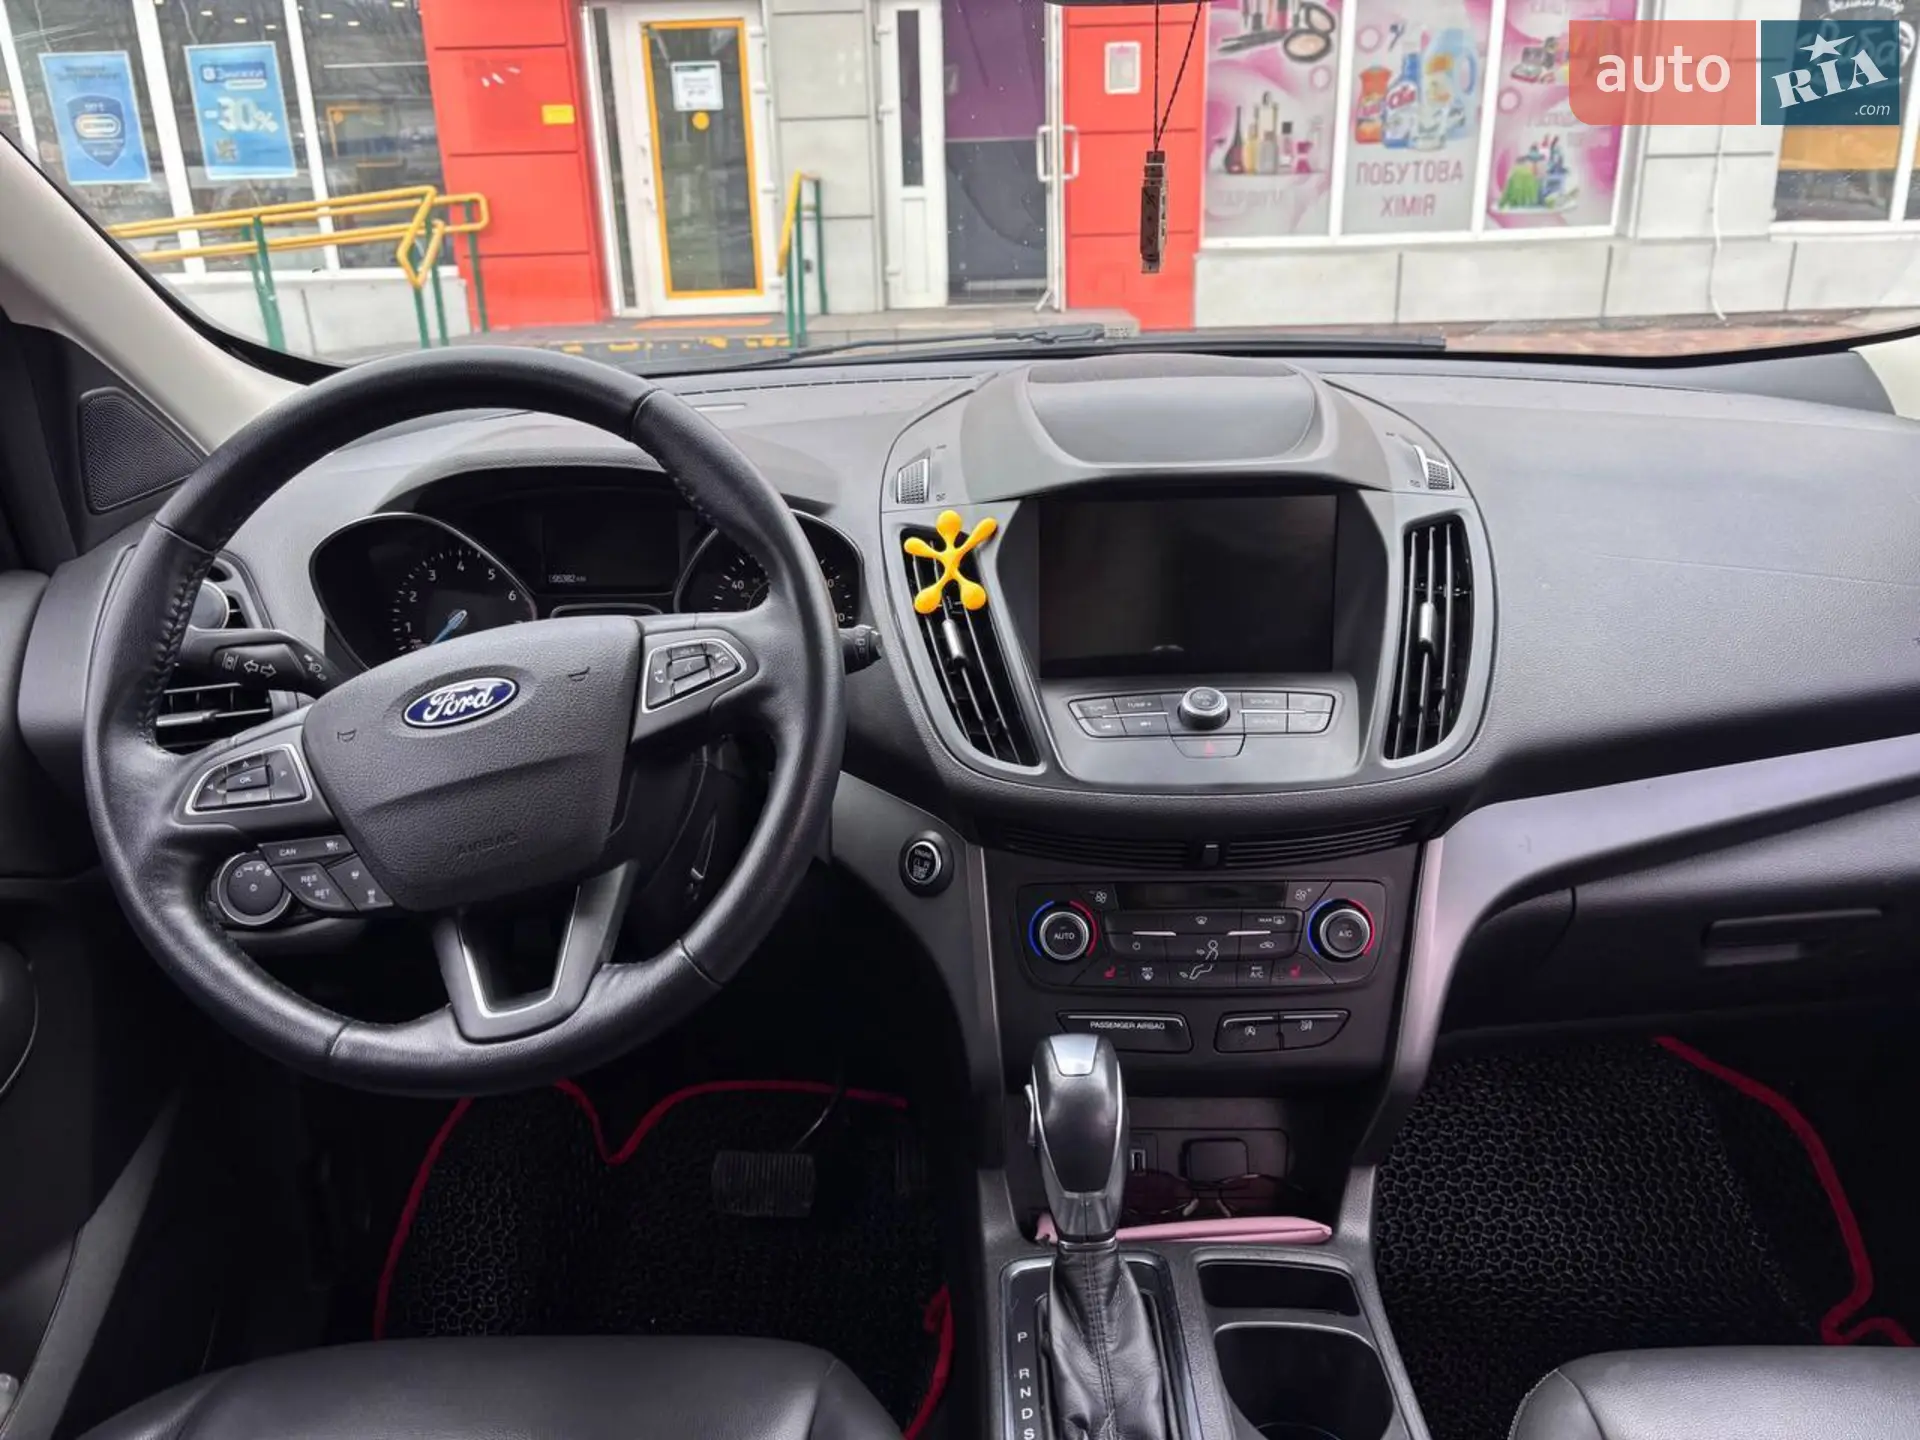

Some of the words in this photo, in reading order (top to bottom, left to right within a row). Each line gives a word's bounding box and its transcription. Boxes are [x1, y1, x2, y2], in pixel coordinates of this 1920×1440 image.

[1355, 160, 1464, 185] ПОБУТОВА
[1380, 194, 1437, 217] ХІМІЯ
[457, 560, 465, 572] 4
[428, 569, 437, 581] 3
[488, 568, 496, 581] 5
[731, 579, 745, 590] 40
[409, 591, 418, 602] 2
[508, 590, 517, 602] 6
[404, 621, 412, 633] 1
[422, 682, 504, 721] Ford
[1054, 931, 1076, 940] AUTO
[1338, 929, 1354, 938] A/C
[1090, 1021, 1136, 1030] PASSENGER
[1017, 1331, 1028, 1343] P
[1018, 1367, 1030, 1380] R
[1020, 1386, 1032, 1399] N
[1021, 1407, 1034, 1420] D
